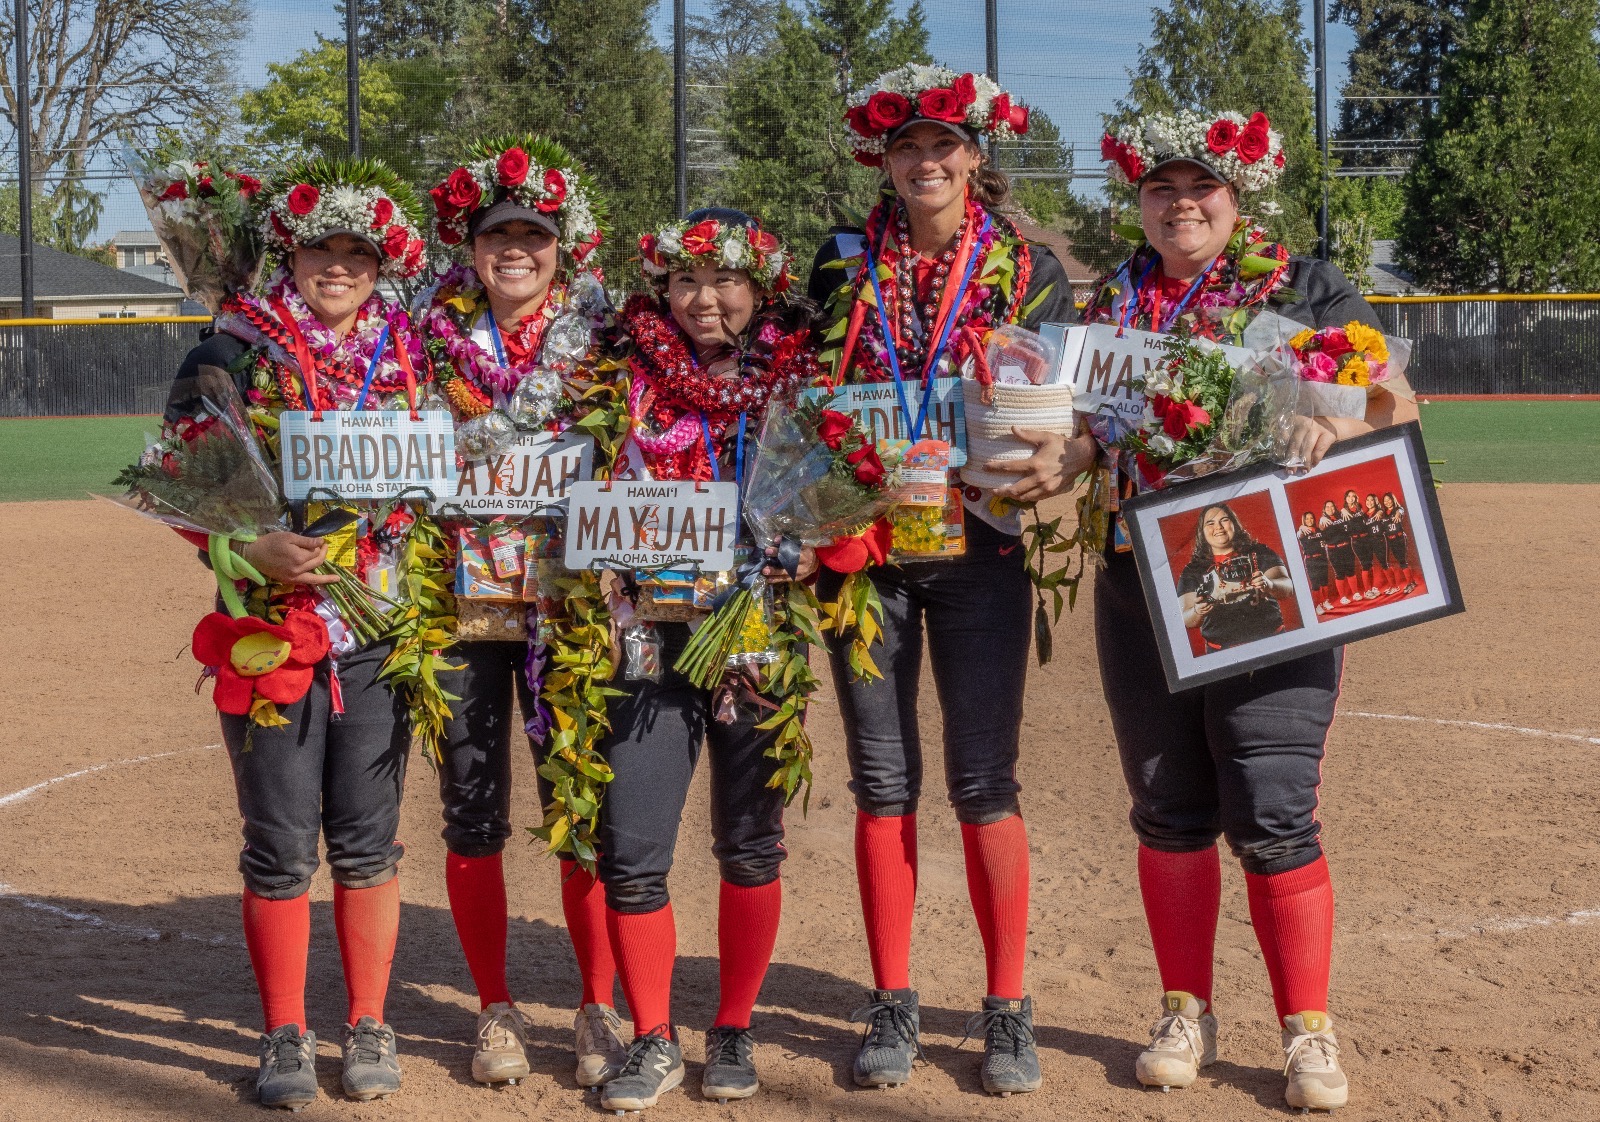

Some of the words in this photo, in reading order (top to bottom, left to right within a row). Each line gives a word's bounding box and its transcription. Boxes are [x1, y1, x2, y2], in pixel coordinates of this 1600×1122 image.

[290, 433, 447, 480] BRADDAH
[332, 483, 373, 493] ALOHA
[455, 454, 581, 497] AYJAH
[462, 499, 503, 509] ALOHA
[506, 500, 544, 509] STATE
